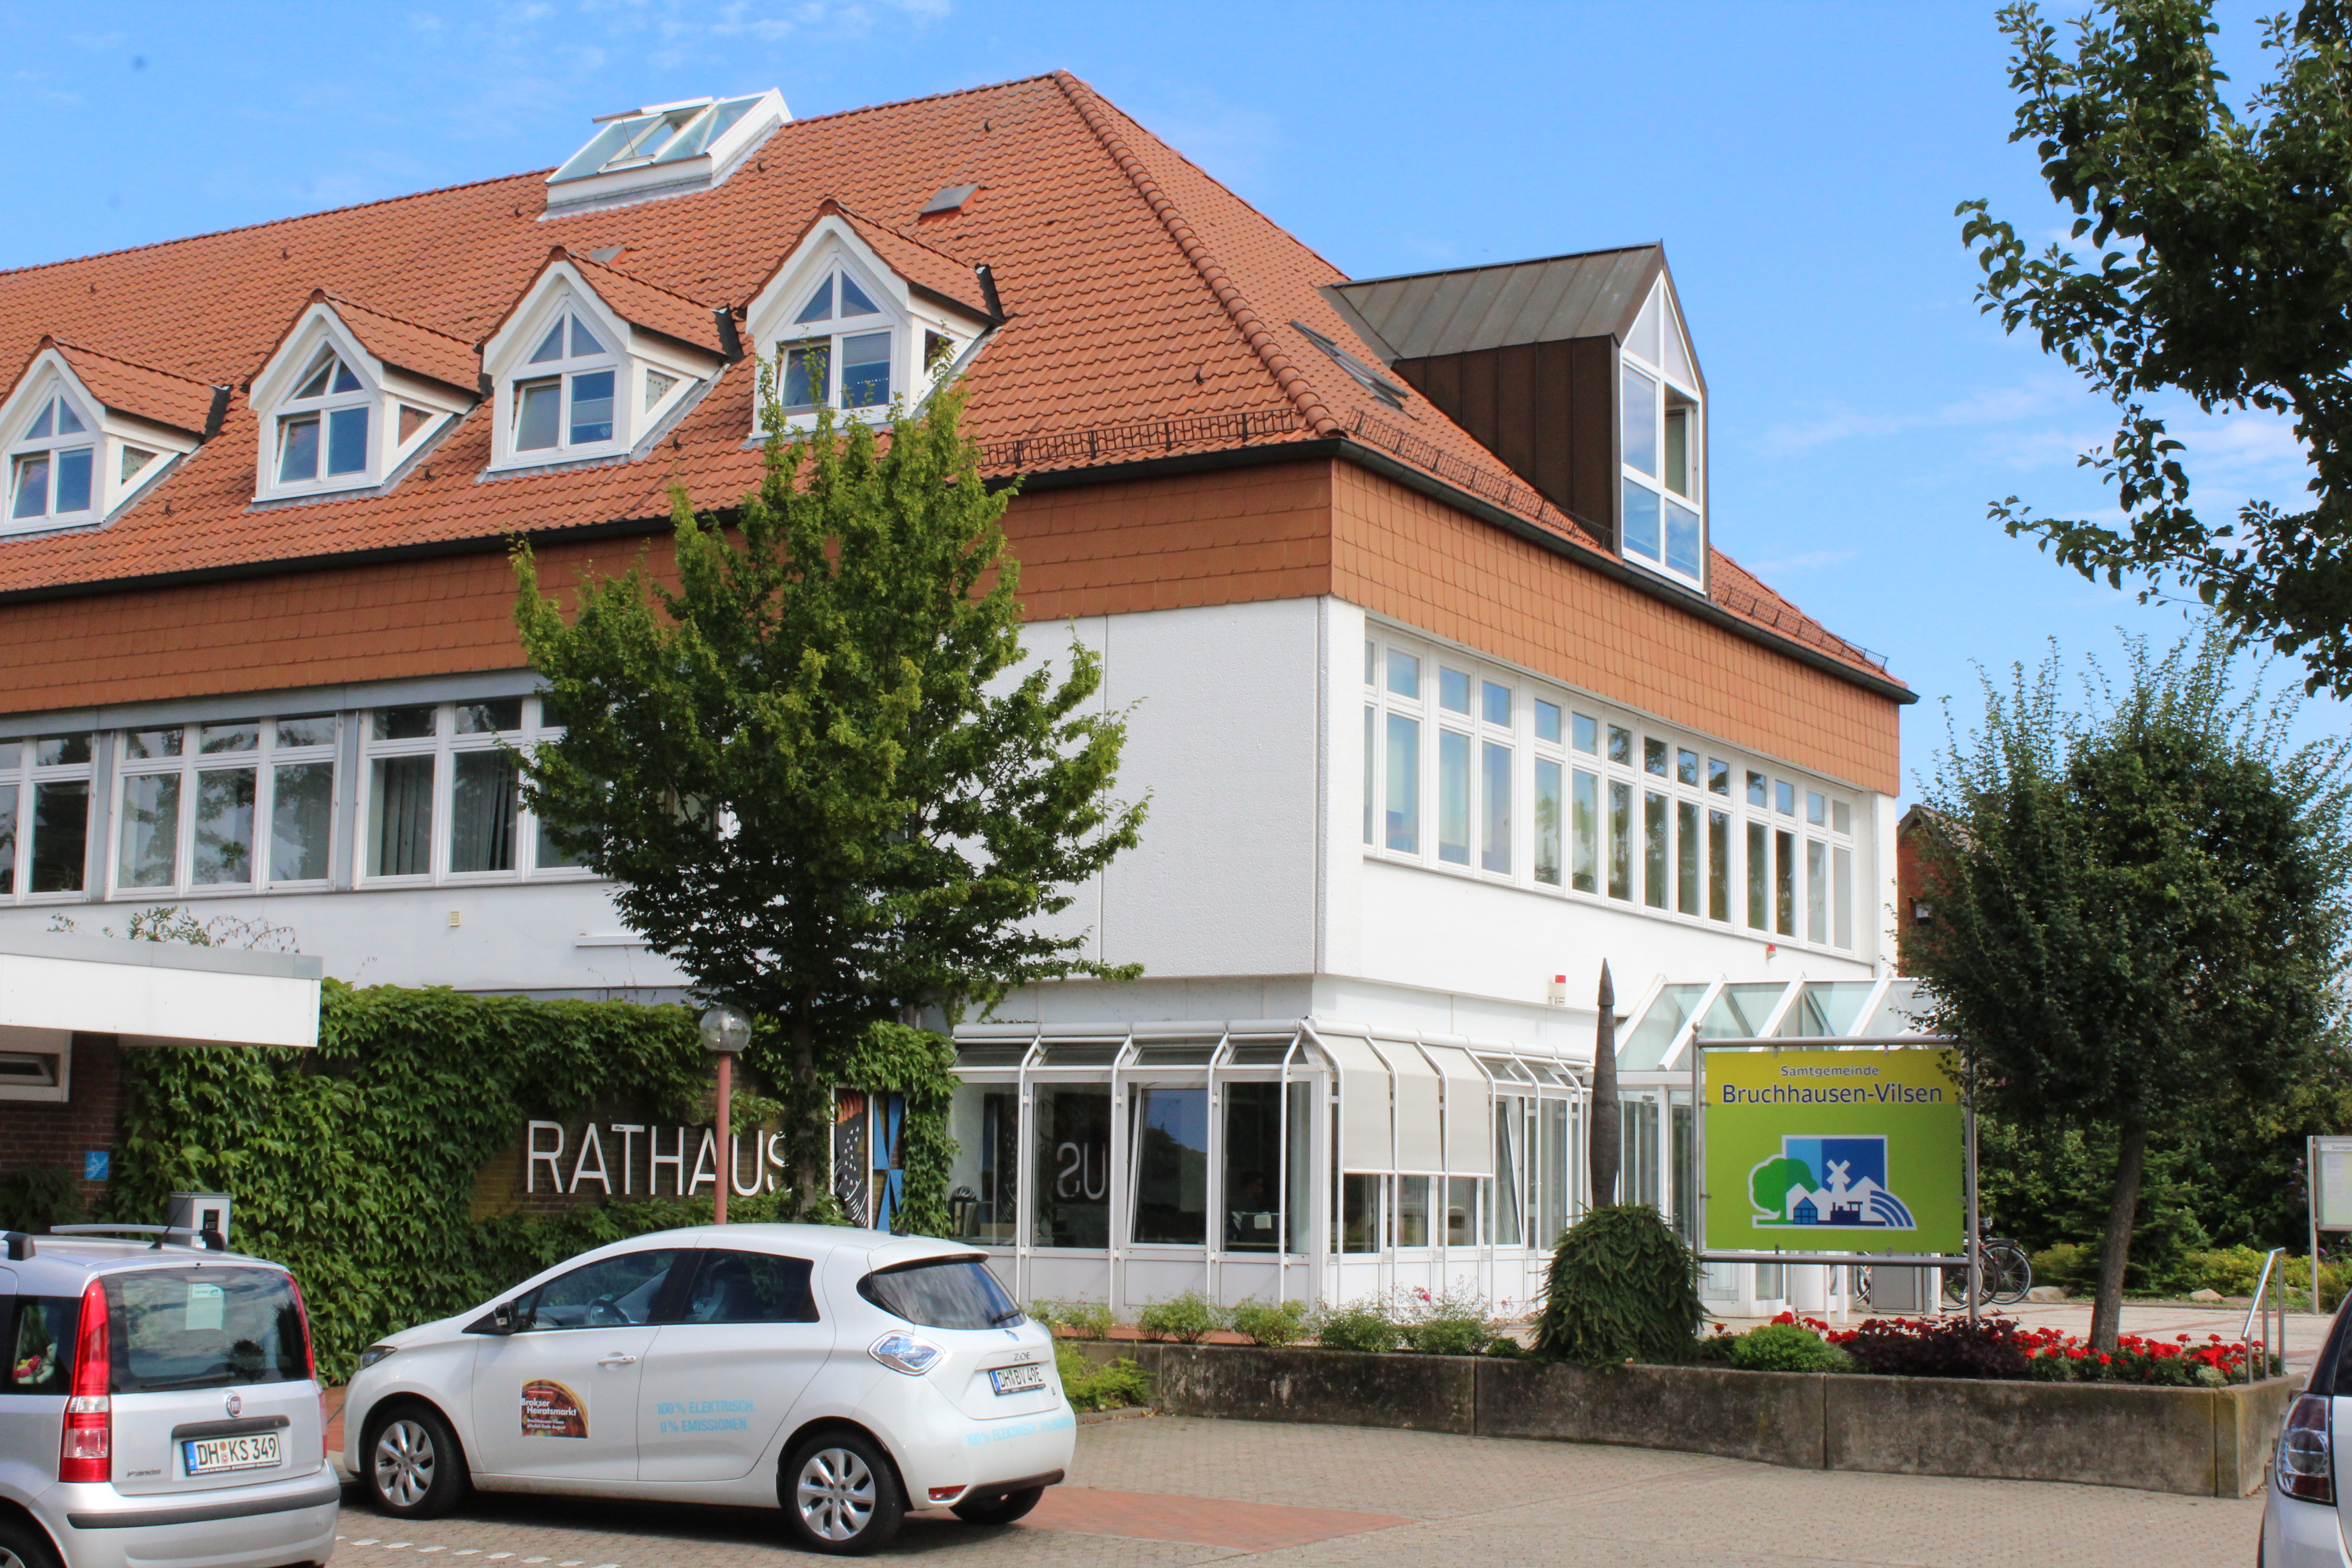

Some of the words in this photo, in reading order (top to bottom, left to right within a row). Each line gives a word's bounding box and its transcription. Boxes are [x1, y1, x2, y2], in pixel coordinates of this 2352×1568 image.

[1780, 1064, 1879, 1077] Samtgemeinde
[1722, 1082, 1942, 1104] Bruchhausen-Vilsen
[1014, 1351, 1031, 1361] ZOE
[997, 1370, 1012, 1387] DH
[1014, 1368, 1026, 1385] BV
[1027, 1366, 1043, 1382] 49E
[522, 1397, 551, 1406] Brokser
[527, 1406, 577, 1416] Heiratsmarkt
[196, 1442, 220, 1465] DH
[228, 1439, 249, 1462] KS
[250, 1436, 276, 1460] 349
